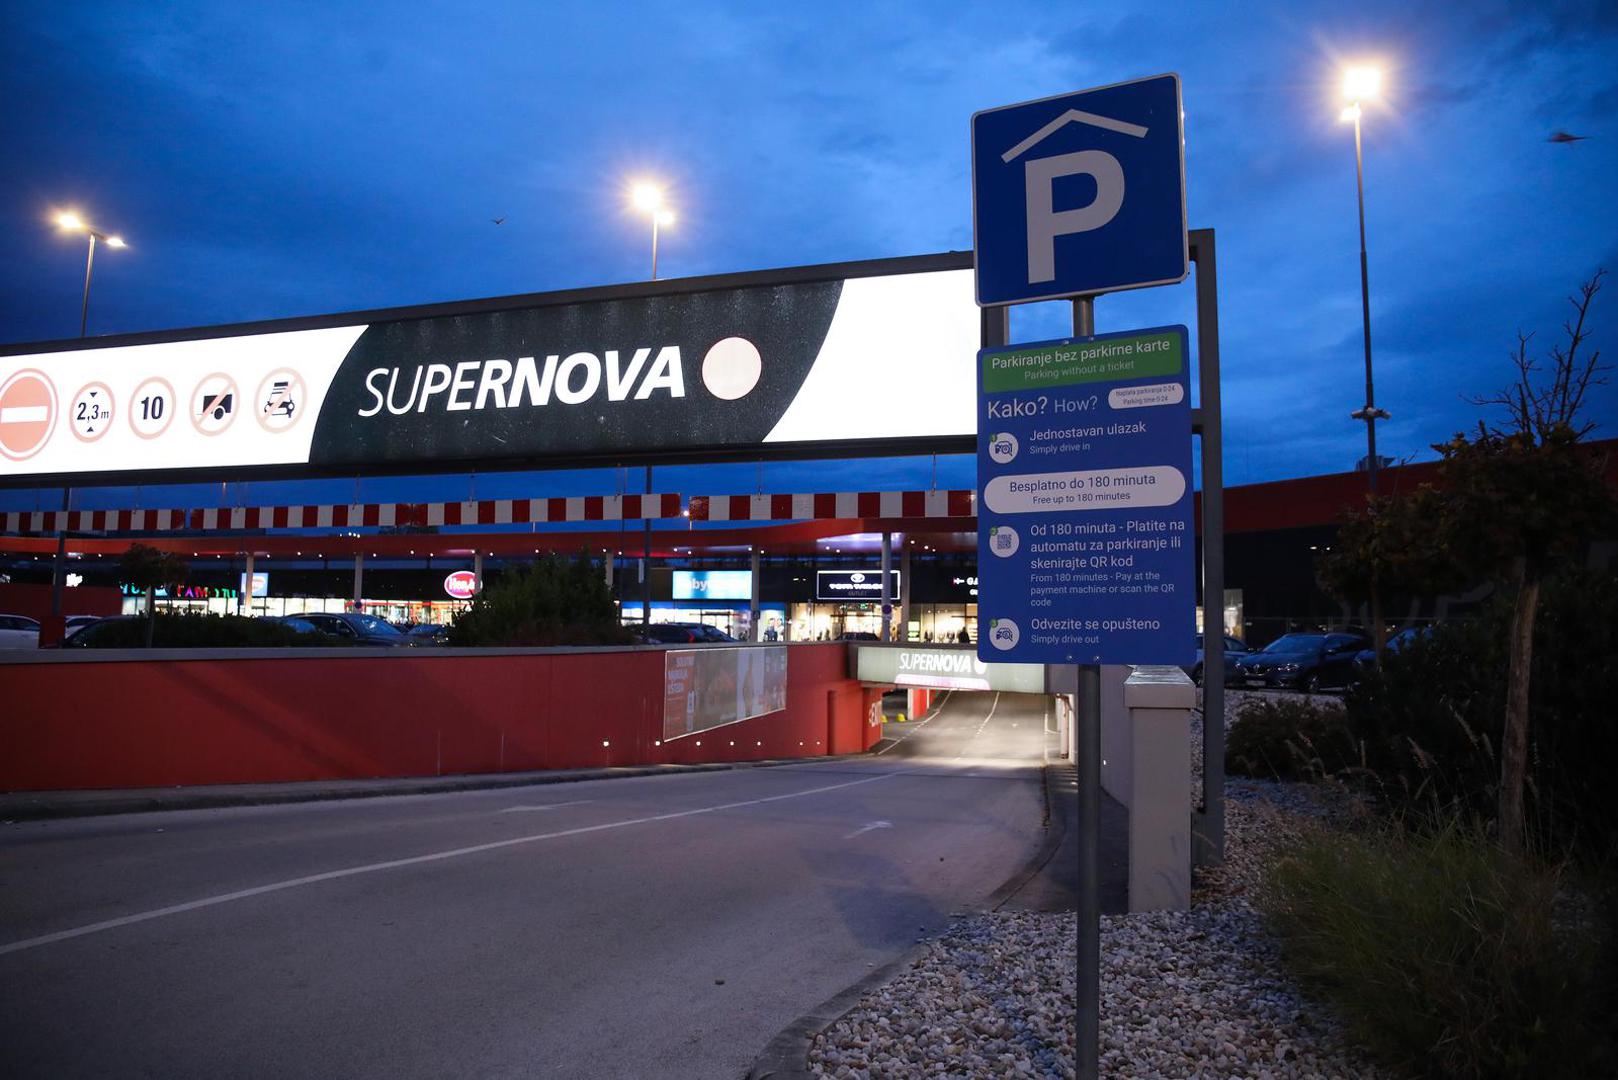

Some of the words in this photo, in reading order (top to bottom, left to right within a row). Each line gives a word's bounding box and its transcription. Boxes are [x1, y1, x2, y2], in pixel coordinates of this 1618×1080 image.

[1025, 150, 1125, 284] P
[992, 352, 1052, 369] Parkiranje
[1055, 350, 1077, 362] bez
[1081, 344, 1133, 361] parkirne
[1136, 340, 1170, 353] karte
[1024, 369, 1059, 380] Parking
[1062, 365, 1098, 376] without
[1108, 360, 1134, 371] ticket
[358, 345, 685, 417] SUPERNOVA
[141, 395, 164, 420] 10
[988, 396, 1048, 419] Kako?
[1054, 396, 1098, 413] How?
[1029, 425, 1104, 441] Jednostavan
[1107, 421, 1146, 435] ulazak
[1029, 445, 1057, 455] Simply
[1059, 443, 1080, 452] drive
[1082, 442, 1091, 450] in
[1009, 479, 1066, 494] Besplatno
[1070, 477, 1085, 489] do
[1089, 476, 1110, 487] 180
[1113, 474, 1155, 486] minuta
[1032, 496, 1050, 504] Free
[1054, 496, 1064, 505] up
[1066, 494, 1075, 502] to
[1077, 493, 1093, 502] 180
[1095, 491, 1131, 501] minutes
[1030, 524, 1046, 536] Od
[1050, 524, 1071, 535] 180
[1075, 522, 1116, 534] minuta
[1126, 520, 1166, 532] Platite
[1170, 520, 1185, 531] na
[1030, 541, 1086, 553] automatu
[1089, 541, 1104, 551] za
[1107, 538, 1168, 553] parkiranje
[1170, 536, 1181, 548] ili
[1030, 557, 1087, 571] skenirajte
[1090, 556, 1108, 568] QR
[1110, 555, 1133, 567] kod
[1030, 573, 1052, 582] From
[1055, 573, 1071, 582] 180
[1073, 572, 1108, 581] minutes
[1115, 572, 1132, 582] Pay
[1135, 572, 1143, 580] at
[1145, 571, 1160, 580] the
[1030, 586, 1067, 596] payment
[1069, 585, 1106, 594] machine
[1108, 585, 1118, 593] or
[1119, 585, 1141, 593] scan
[1144, 584, 1159, 593] the
[1160, 583, 1175, 593] QR
[1030, 598, 1052, 607] code
[1031, 618, 1082, 630] Odvezite
[1085, 619, 1099, 630] se
[1102, 617, 1160, 633] opušteno
[1030, 634, 1059, 645] Simply
[1061, 634, 1083, 643] drive
[1084, 634, 1099, 643] out
[898, 652, 972, 673] SUPERNOVA
